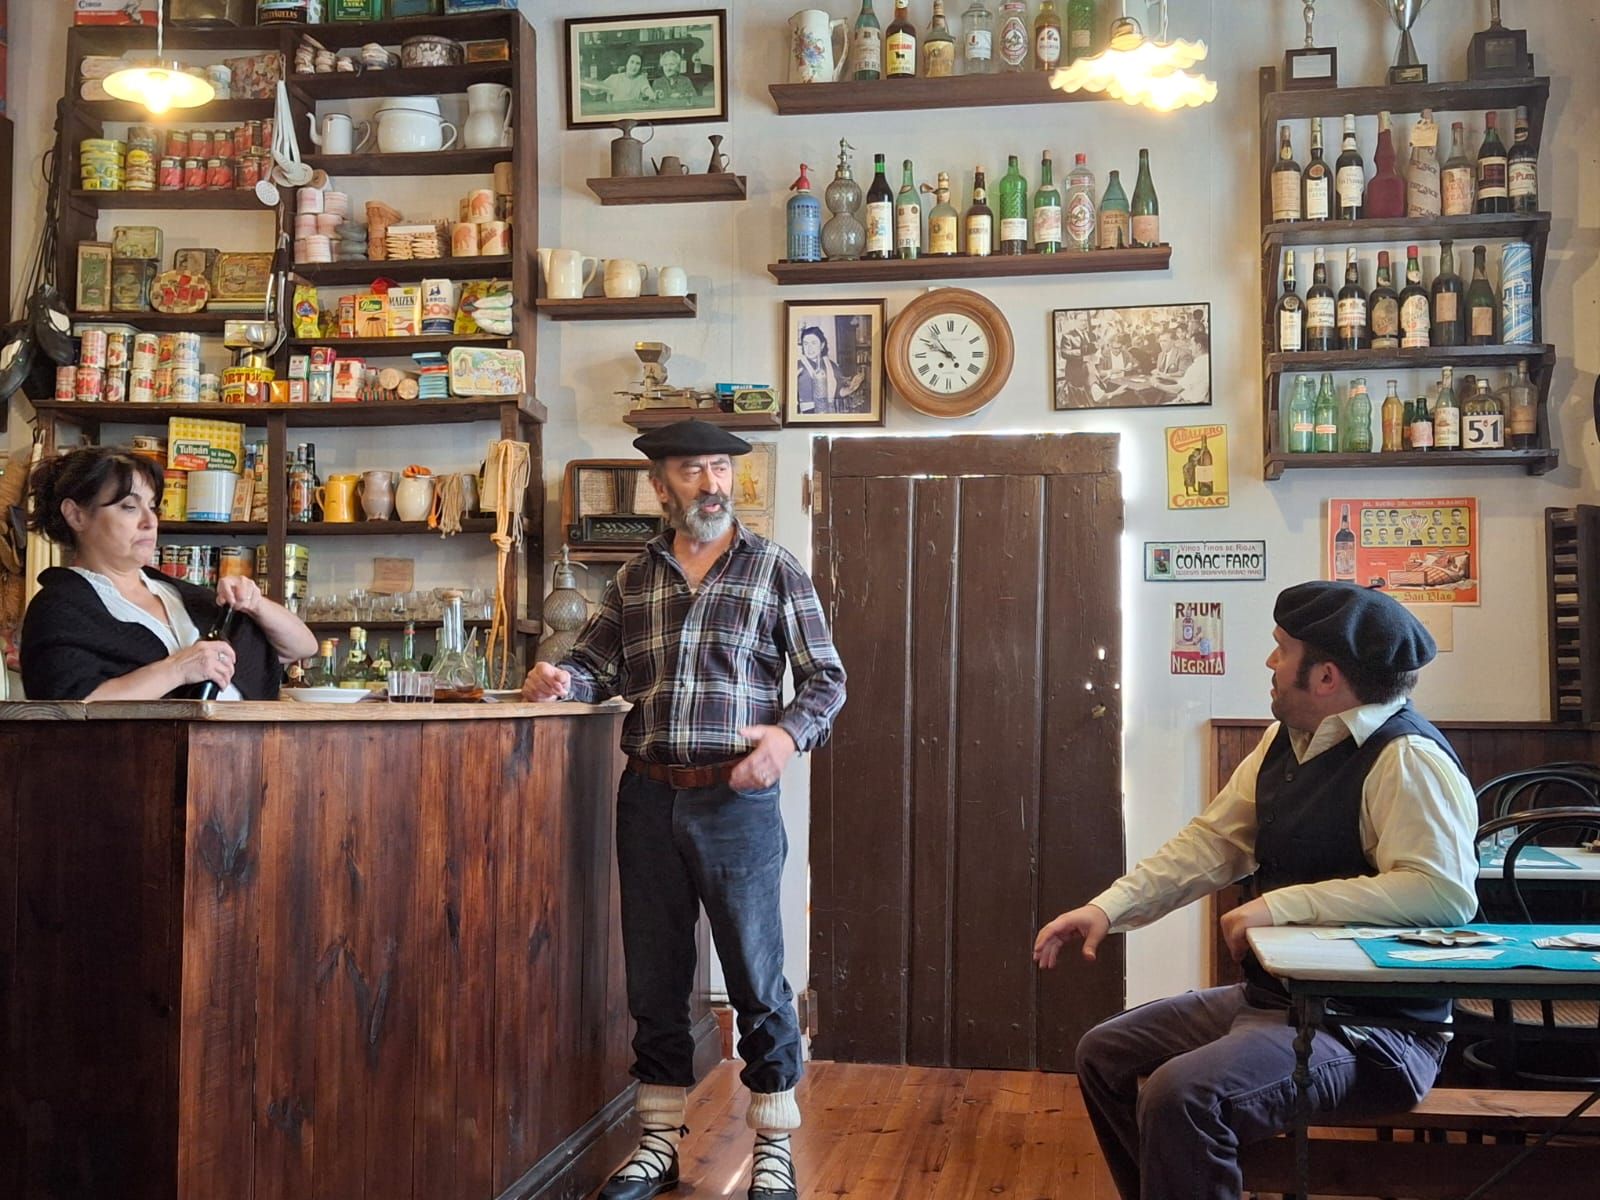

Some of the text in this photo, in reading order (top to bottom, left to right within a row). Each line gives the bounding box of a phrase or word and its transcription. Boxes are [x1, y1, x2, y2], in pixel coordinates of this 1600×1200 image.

[424, 304, 450, 316] SOS
[1170, 426, 1224, 453] CABALLERO
[1468, 419, 1500, 443] 51
[179, 445, 209, 456] Tulipán
[1176, 552, 1220, 569] COÑAC
[1175, 602, 1221, 619] RHUM
[1172, 655, 1224, 674] NEGRITA
